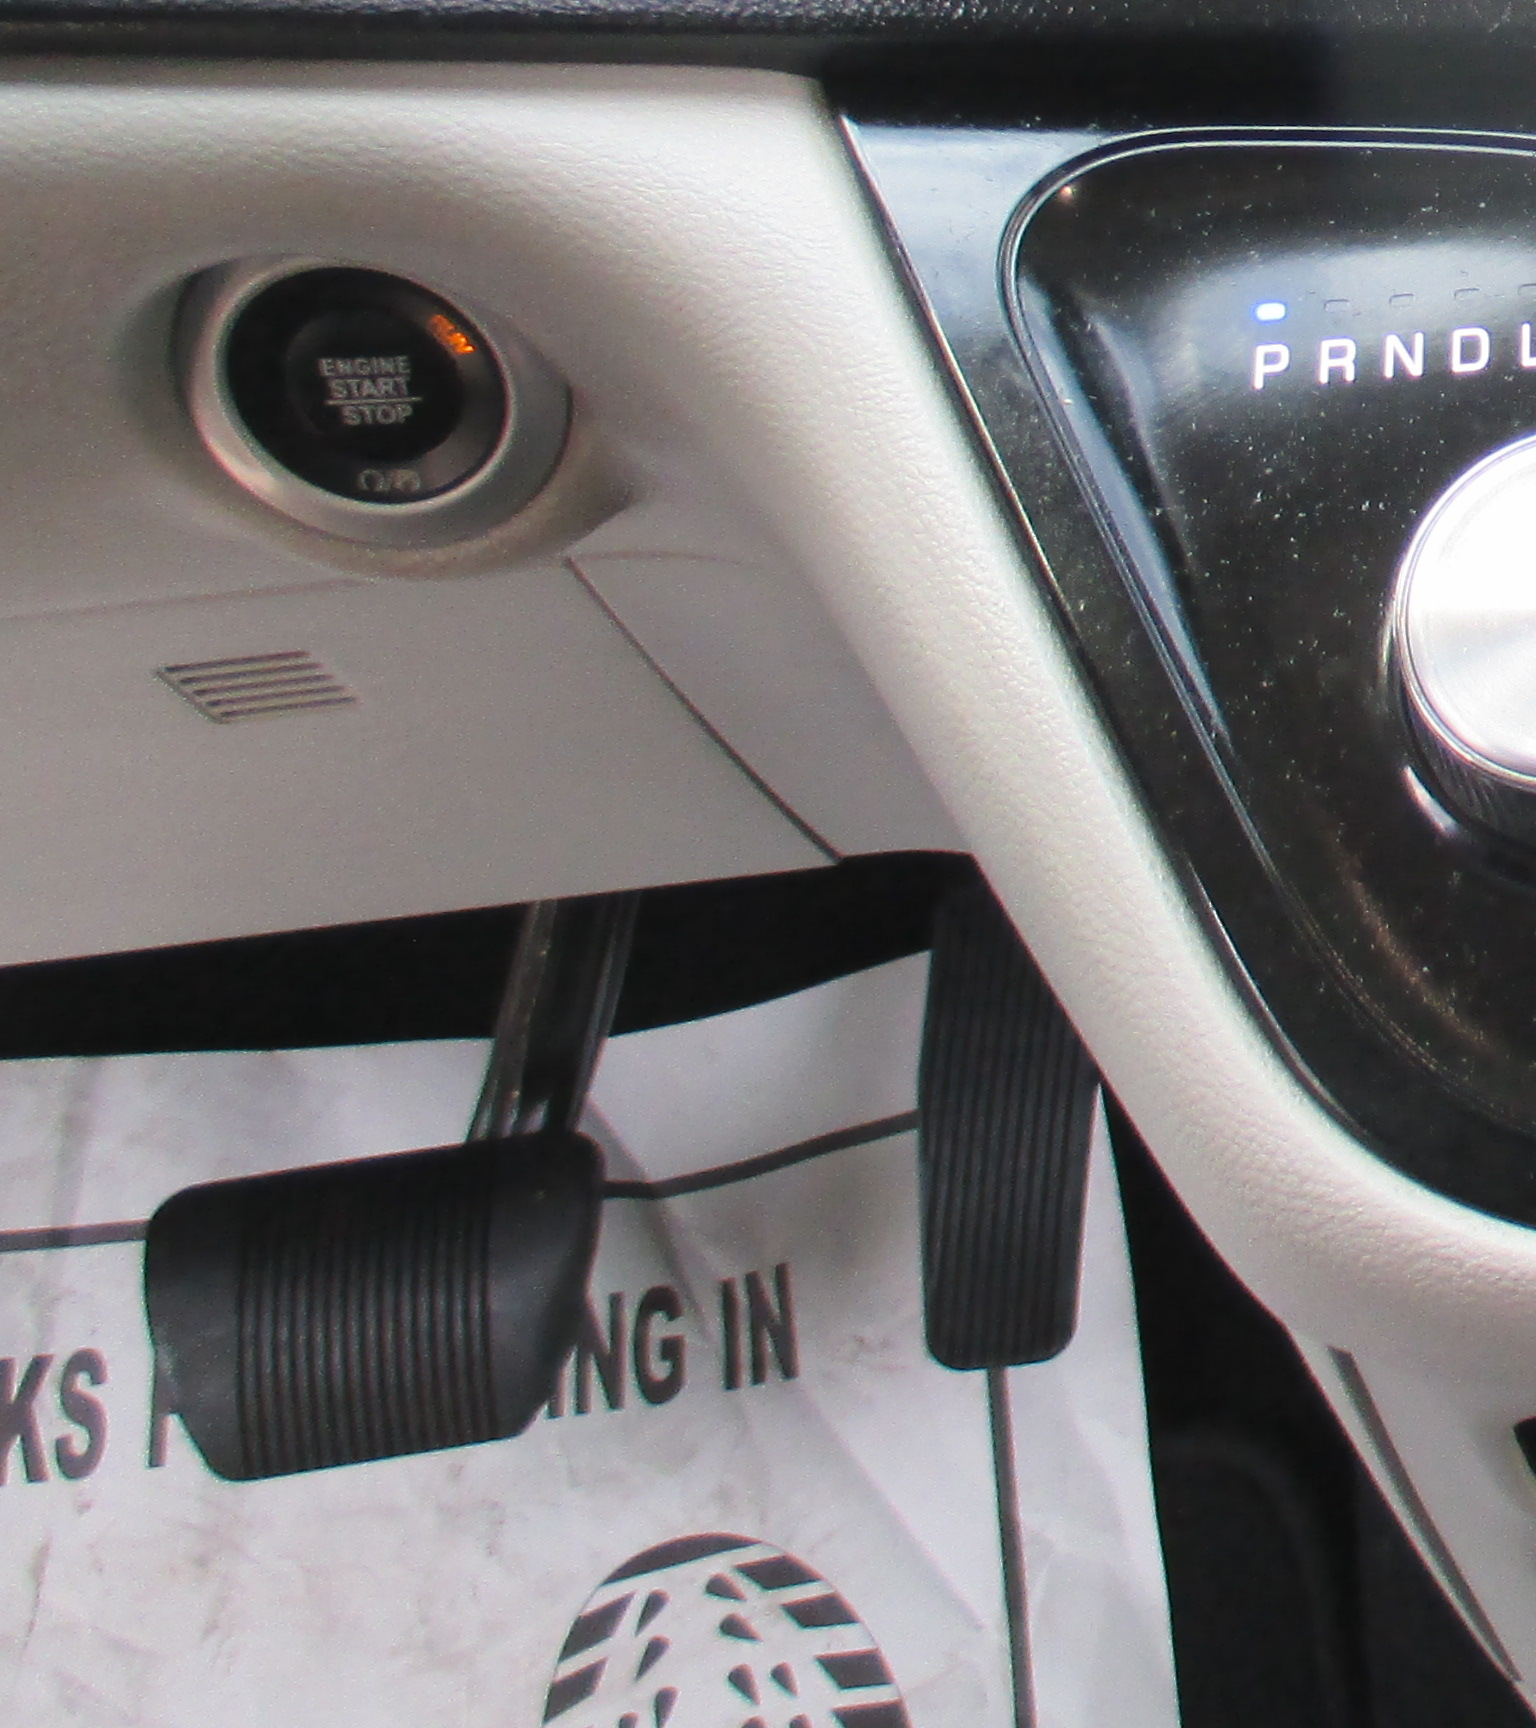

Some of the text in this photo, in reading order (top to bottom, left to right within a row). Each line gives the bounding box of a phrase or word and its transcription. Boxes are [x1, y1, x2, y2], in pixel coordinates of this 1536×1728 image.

[318, 354, 411, 377] ENGINE
[328, 376, 410, 399] START
[341, 403, 413, 426] STOP
[717, 1262, 801, 1391] IN
